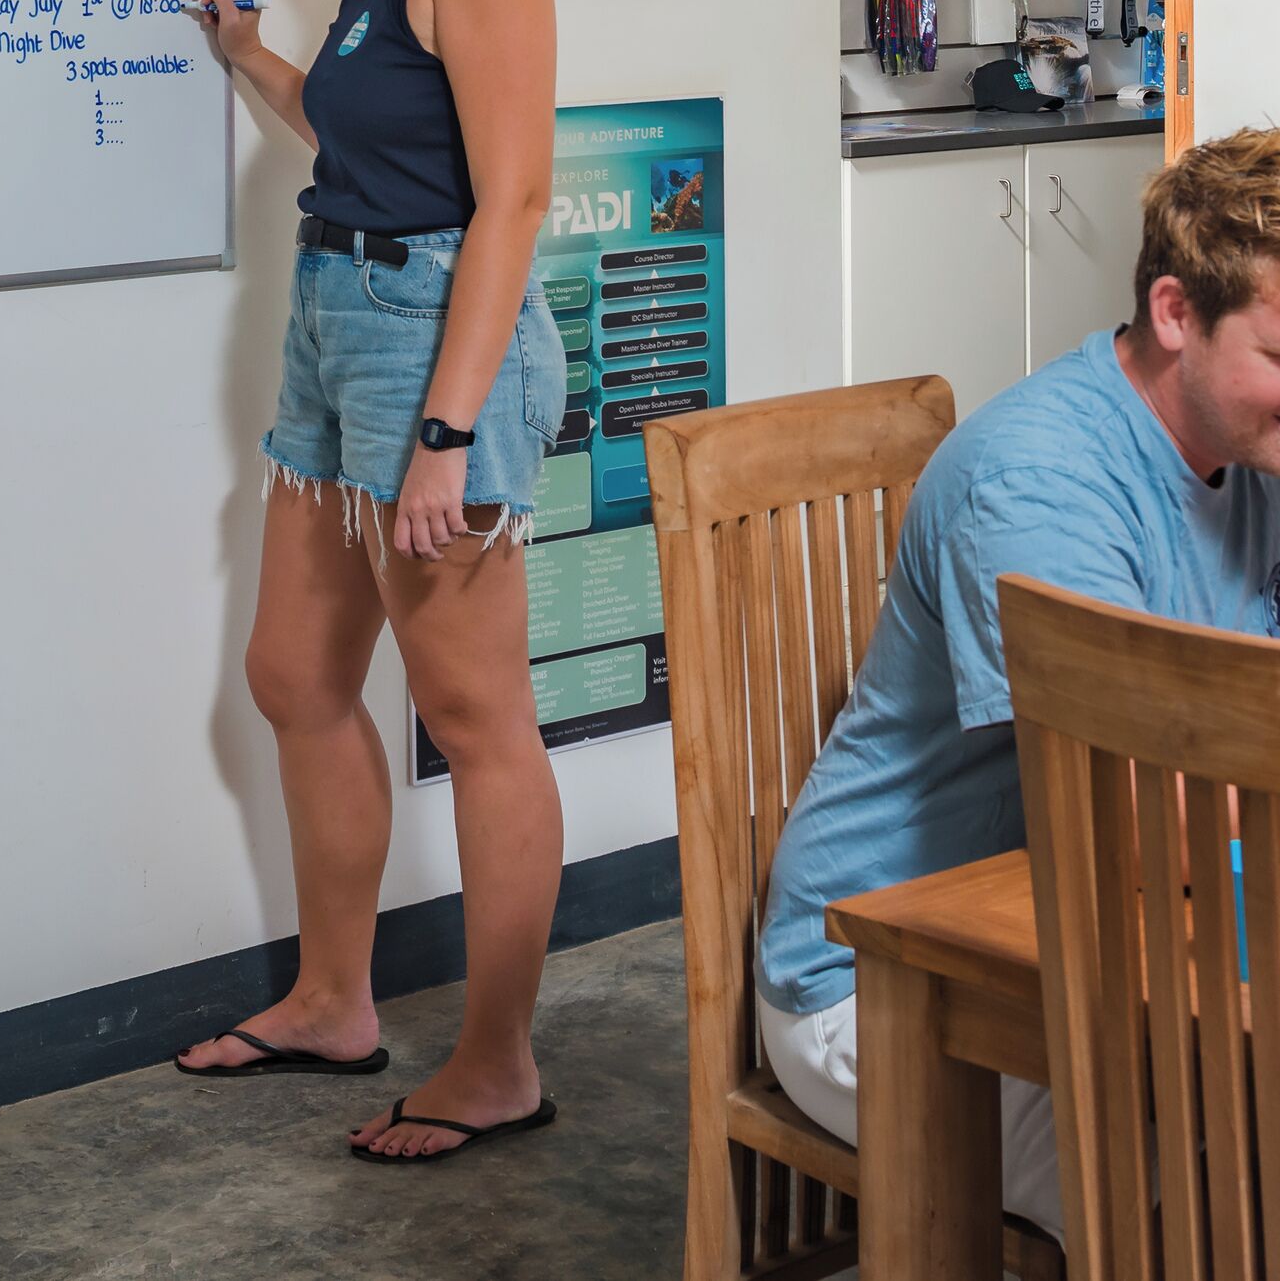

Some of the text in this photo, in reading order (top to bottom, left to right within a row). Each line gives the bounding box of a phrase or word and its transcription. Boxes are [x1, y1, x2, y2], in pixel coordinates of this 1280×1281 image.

[50, 29, 86, 51] Dive
[66, 53, 194, 83] 3 spots available:
[590, 127, 664, 144] ADVENTURE
[553, 169, 609, 185] EXPLORE
[552, 190, 632, 236] PADI
[634, 251, 675, 264] Course Director
[633, 281, 676, 293] Master Instructor
